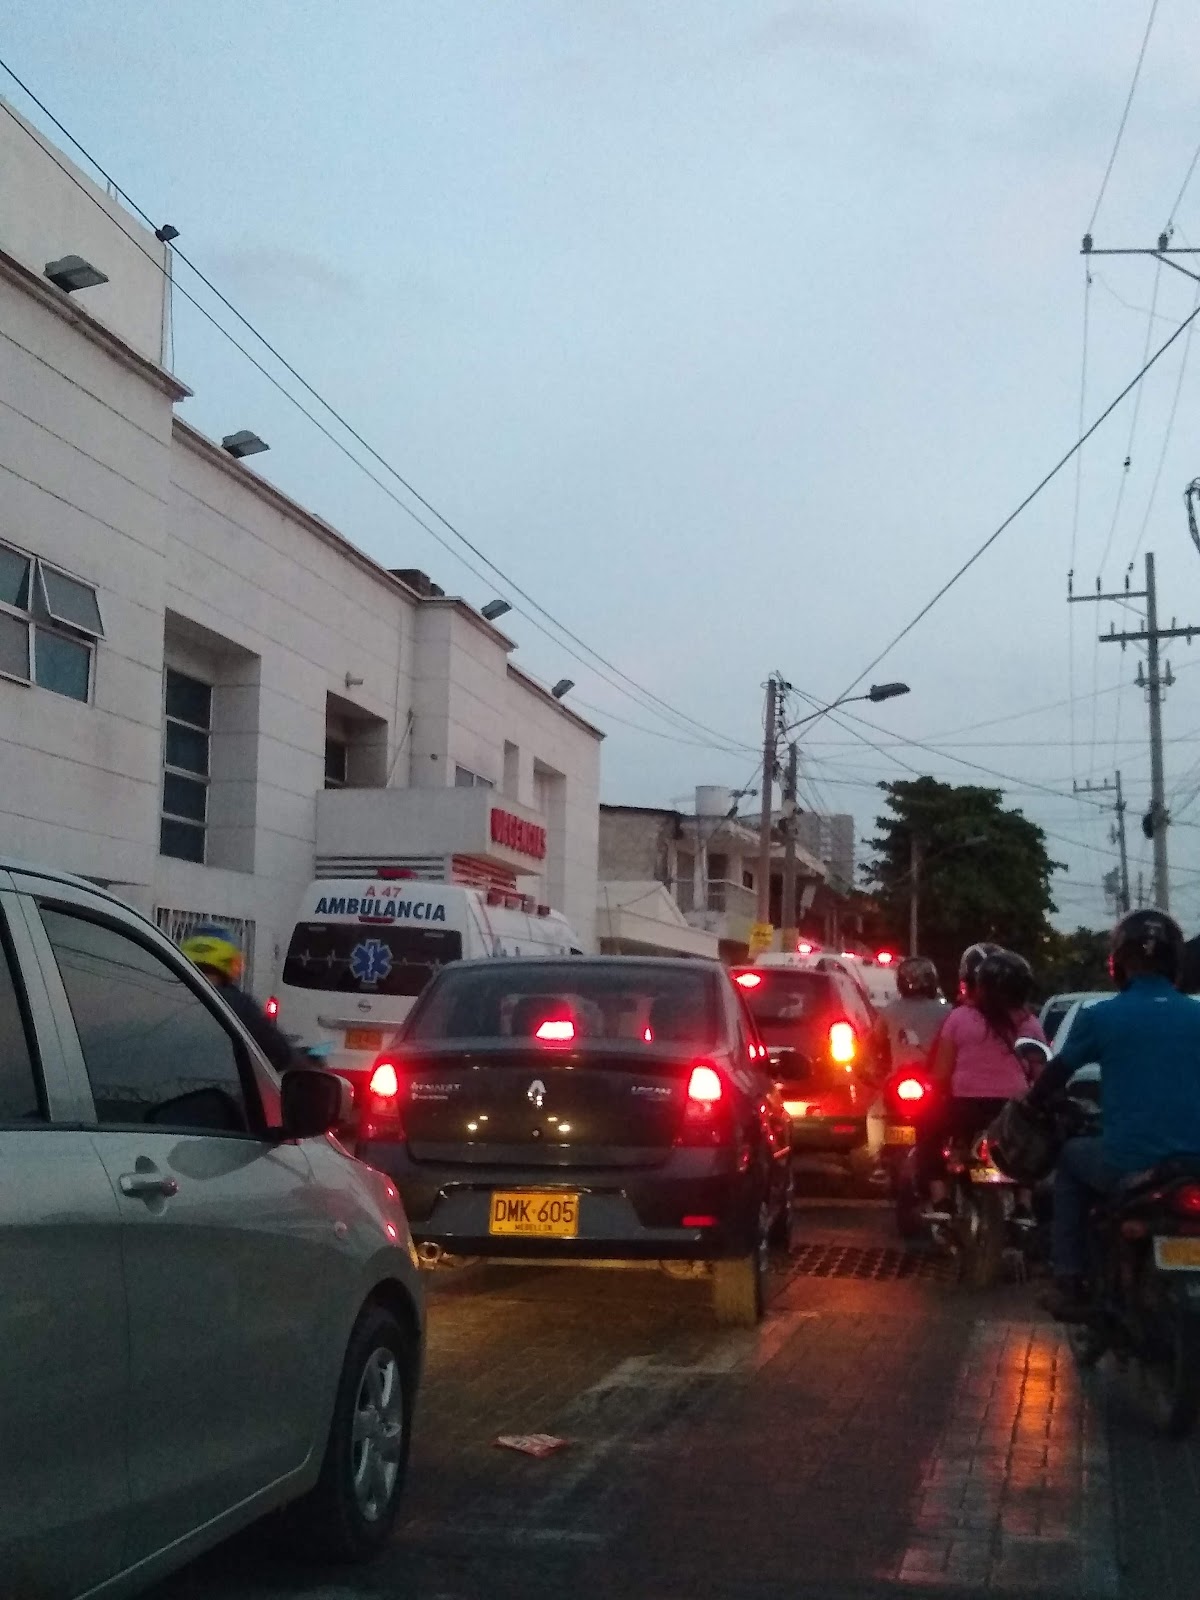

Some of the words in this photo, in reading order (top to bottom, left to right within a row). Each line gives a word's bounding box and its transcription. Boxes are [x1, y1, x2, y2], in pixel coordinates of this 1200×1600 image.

[365, 885, 376, 897] A
[381, 886, 402, 898] 47
[315, 897, 446, 921] AMBULANCIA
[494, 1199, 531, 1222] DMK
[537, 1200, 575, 1223] 605
